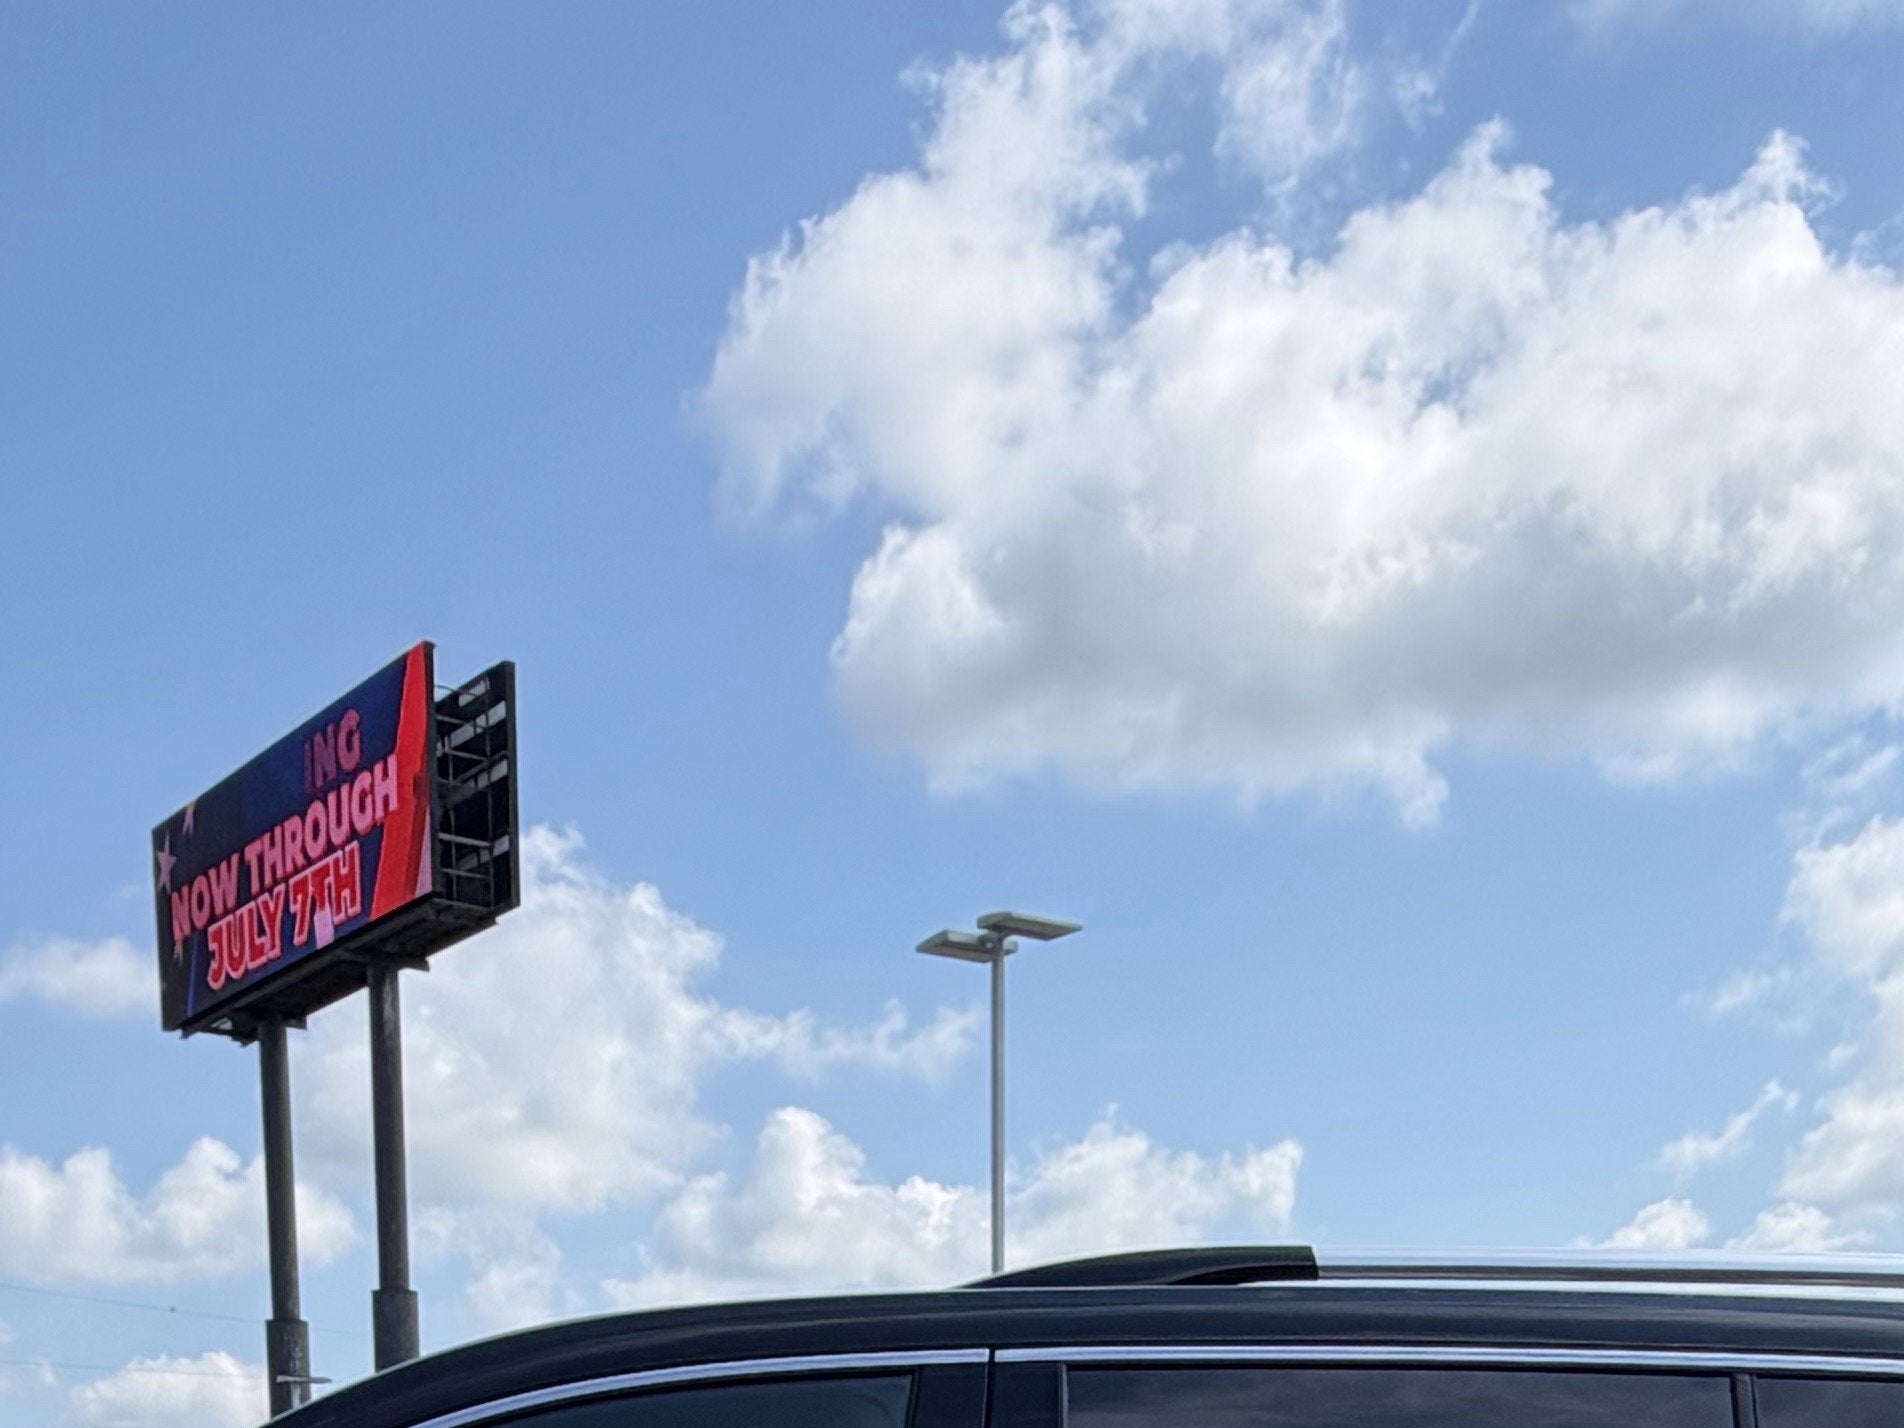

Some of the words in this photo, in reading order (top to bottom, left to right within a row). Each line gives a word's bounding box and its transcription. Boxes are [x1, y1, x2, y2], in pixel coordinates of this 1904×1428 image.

[171, 855, 240, 943] NOW
[244, 752, 398, 897] THROUGH
[207, 884, 285, 991] JULY
[290, 840, 362, 948] 7TH
